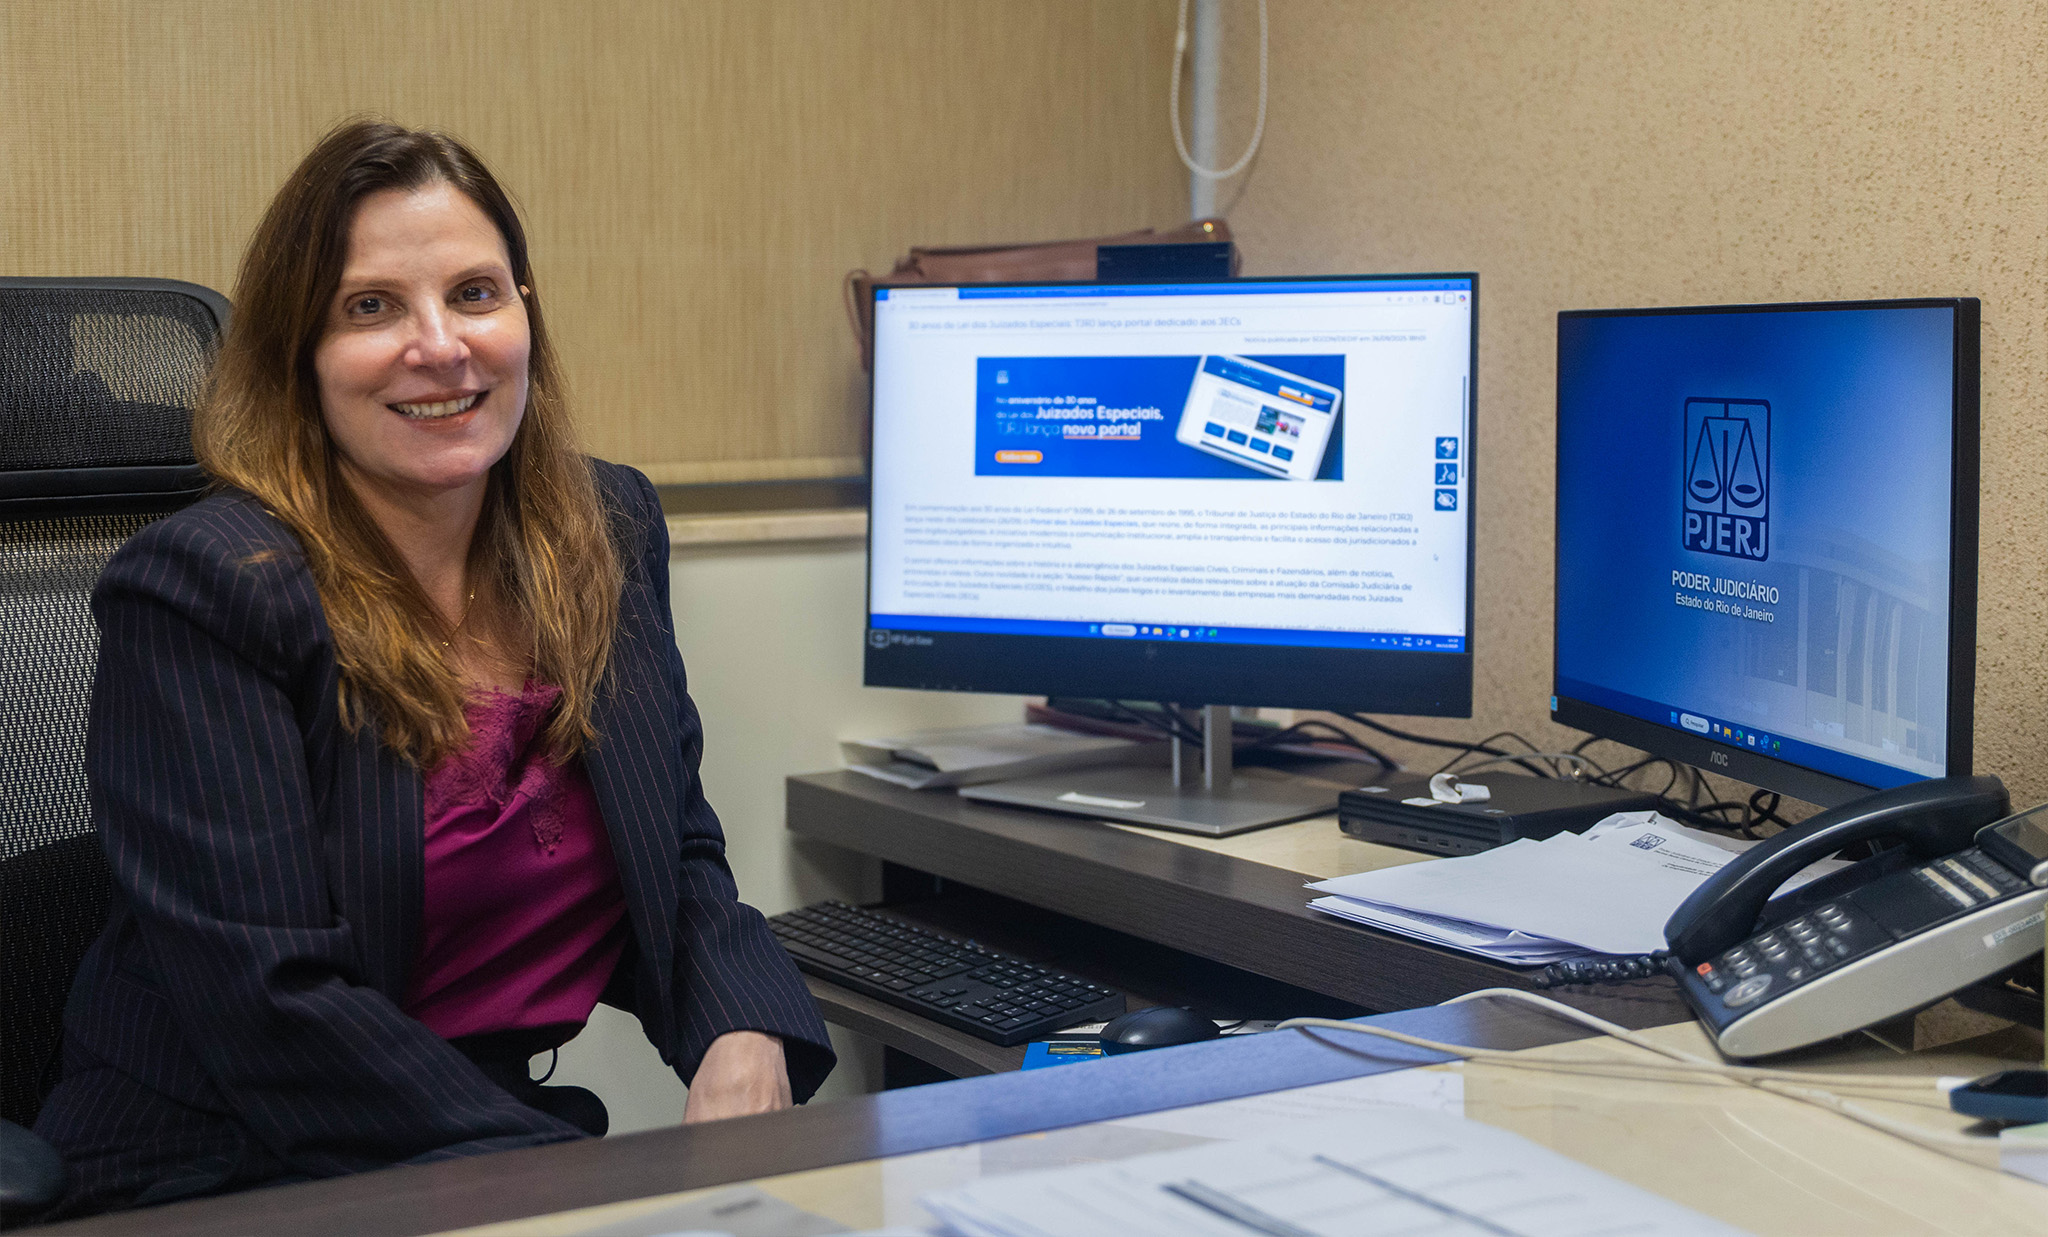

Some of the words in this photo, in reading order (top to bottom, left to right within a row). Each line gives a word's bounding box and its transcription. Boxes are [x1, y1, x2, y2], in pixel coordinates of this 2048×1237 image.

[1036, 405, 1094, 420] Juizados
[1096, 405, 1164, 422] Especiais,
[1062, 424, 1096, 435] novo
[1098, 421, 1141, 439] portal
[1249, 510, 1276, 518] Justiça
[1357, 512, 1387, 520] Janeiro
[1389, 513, 1413, 521] (TJRJ)
[1270, 523, 1308, 531] principais
[1309, 524, 1359, 532] informações
[1348, 537, 1410, 546] jurisdicionados
[1685, 512, 1766, 558] PJERJ
[1276, 567, 1326, 576] Fazendários,
[1327, 568, 1347, 576] além
[1360, 569, 1394, 578] notícias,
[1275, 579, 1307, 588] atuação
[1320, 580, 1359, 588] Comissão
[1361, 582, 1400, 590] Judiciária
[1672, 570, 1711, 592] PODER
[1712, 577, 1779, 604] JUDICIÁRIO
[1237, 591, 1275, 599] empresas
[1297, 592, 1350, 600] demandadas
[1368, 594, 1402, 602] Juizados
[1675, 592, 1702, 608] Estado
[1703, 598, 1714, 611] do
[1716, 600, 1730, 614] Rio
[1731, 603, 1742, 616] de
[1743, 606, 1774, 623] Janeiro
[1710, 751, 1728, 766] AOC
